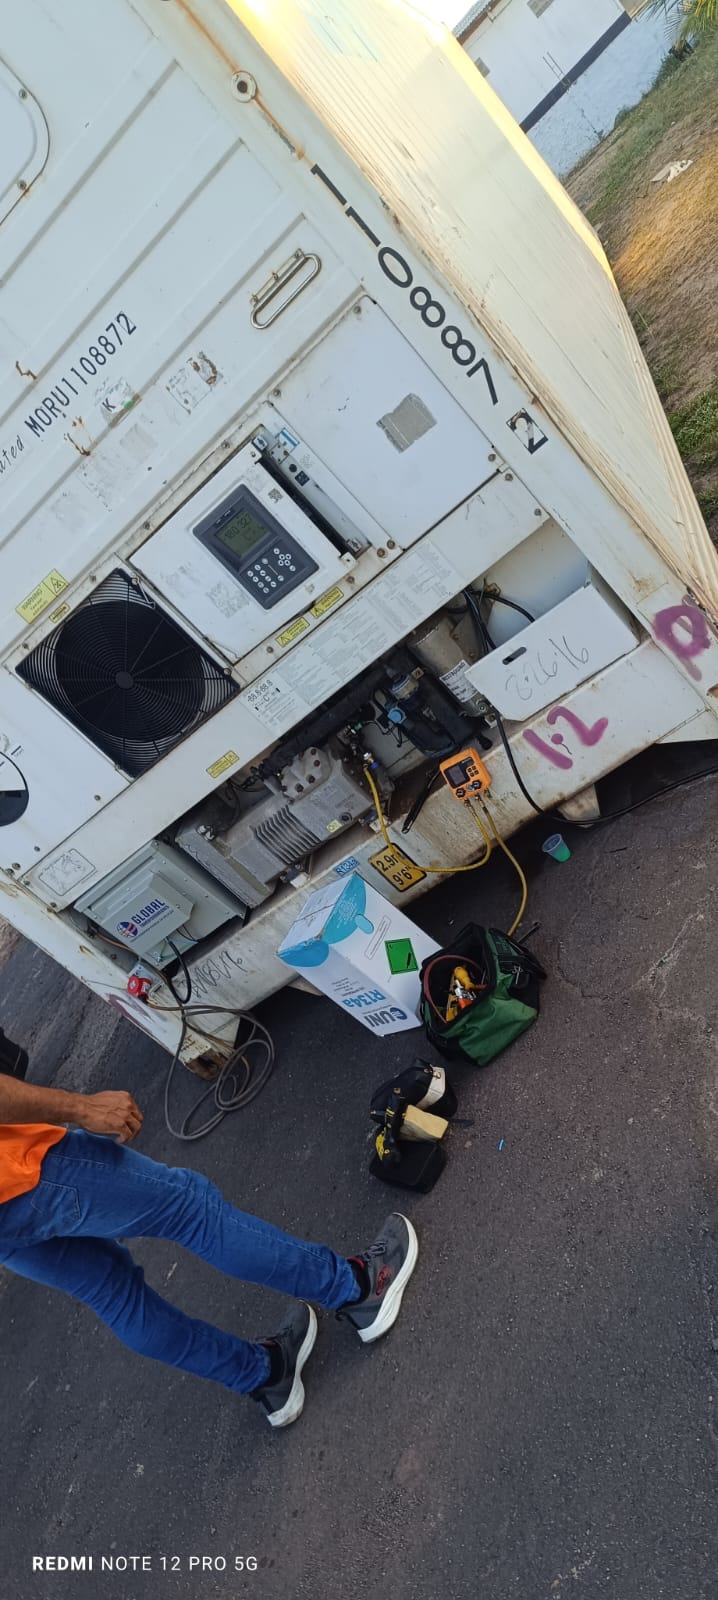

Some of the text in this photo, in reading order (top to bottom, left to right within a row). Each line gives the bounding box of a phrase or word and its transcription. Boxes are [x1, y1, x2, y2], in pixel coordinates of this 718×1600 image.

[24, 310, 138, 438] MORU1108872
[506, 407, 549, 455] 2
[131, 898, 166, 926] GLOBAL
[341, 988, 387, 1008] R134a
